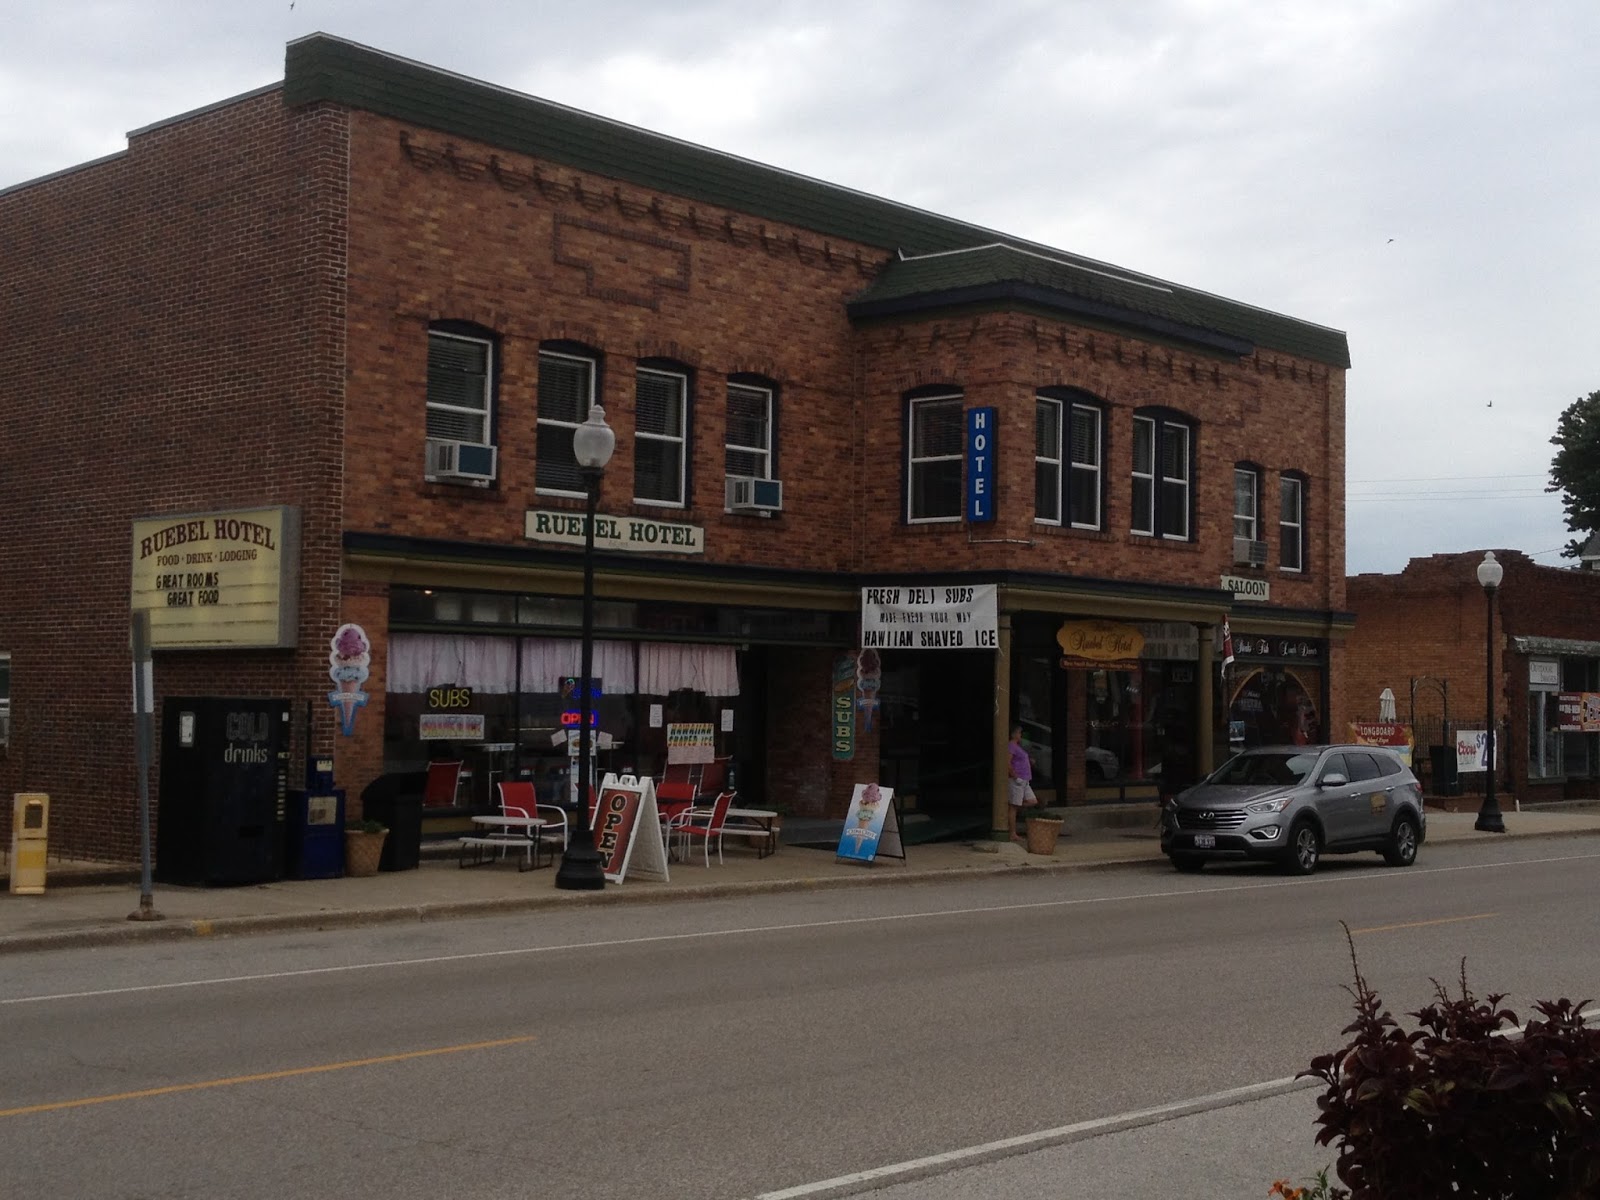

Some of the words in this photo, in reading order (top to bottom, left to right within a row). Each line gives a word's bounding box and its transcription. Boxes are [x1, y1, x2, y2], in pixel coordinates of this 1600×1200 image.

[974, 412, 986, 516] HOTEL
[140, 520, 209, 560] RUEBEL
[213, 519, 275, 551] HOTEL
[629, 522, 696, 546] HOTEL
[156, 554, 180, 566] FOOD
[186, 552, 213, 564] DRINK
[219, 549, 258, 562] LODGING
[156, 574, 184, 589] GREAT
[187, 572, 219, 587] ROOMS
[1227, 579, 1266, 596] SALOON
[167, 591, 194, 606] GREAT
[198, 590, 219, 605] FOOD
[866, 589, 900, 604] FRESH
[908, 589, 935, 604] DELI
[945, 588, 974, 603] SUBS
[864, 630, 913, 646] HAWIIAN
[920, 630, 963, 646] SHAVED
[975, 630, 996, 646] ICE
[428, 688, 470, 708] SUBS
[836, 697, 851, 752] SUBS
[1360, 726, 1396, 736] LONGBOARD
[224, 742, 268, 763] drinks
